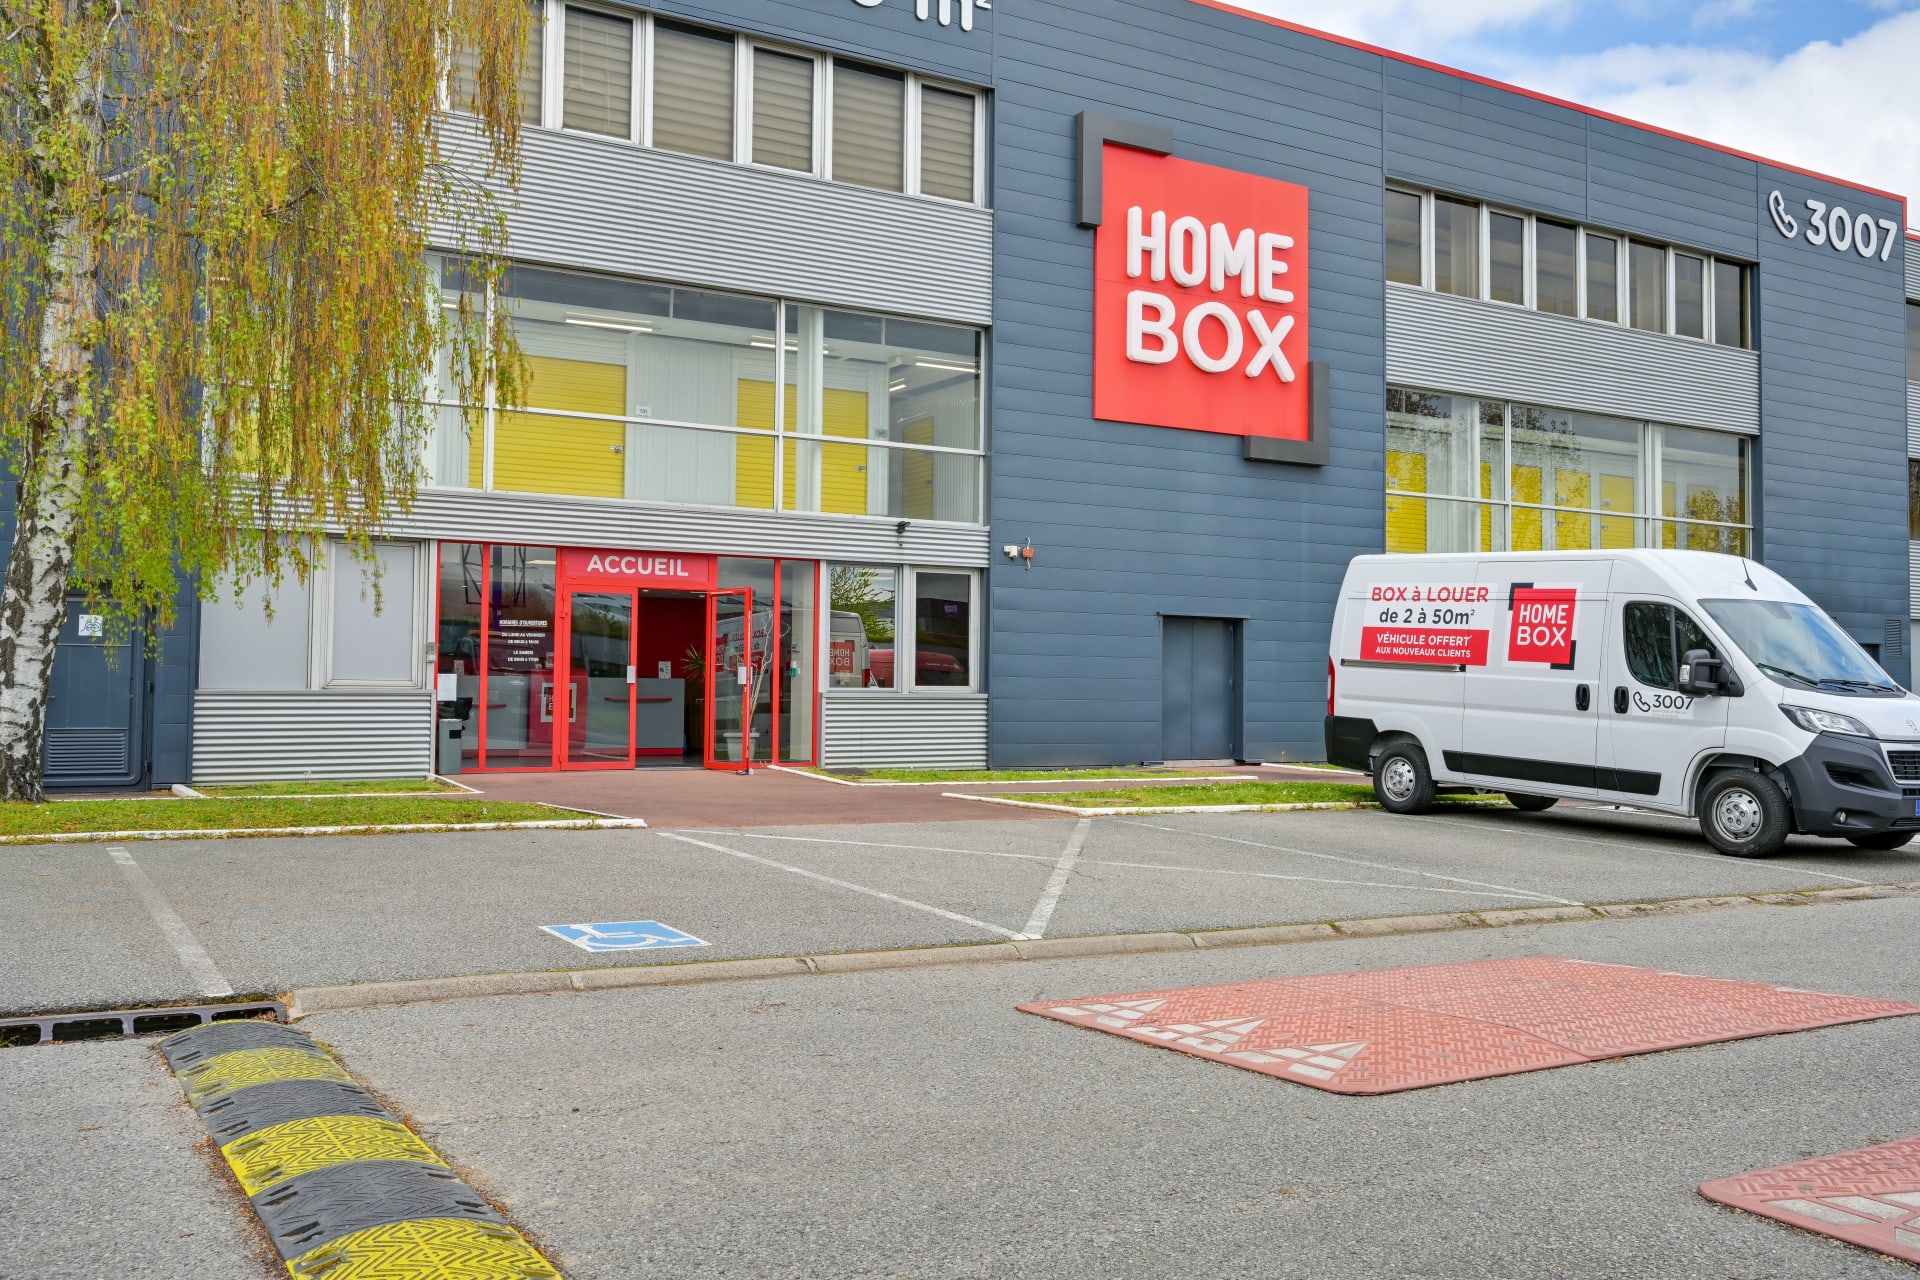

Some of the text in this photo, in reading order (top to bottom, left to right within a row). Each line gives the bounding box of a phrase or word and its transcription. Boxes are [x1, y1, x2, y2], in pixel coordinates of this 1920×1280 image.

[1805, 199, 1898, 262] 3007
[1126, 205, 1295, 303] HOME
[1126, 289, 1295, 383] BOX
[587, 554, 689, 577] ACCUEIL
[1371, 585, 1489, 603] BOX à LOUER
[1379, 608, 1398, 624] de
[1403, 608, 1412, 624] 2
[1417, 607, 1426, 624] à
[1519, 603, 1569, 624] HOME
[1377, 631, 1426, 645] VÉHICULE
[1516, 625, 1567, 647] BOX
[1375, 647, 1471, 658] AUX NOUVEAUX CLIENTS
[1652, 694, 1695, 710] 3007
